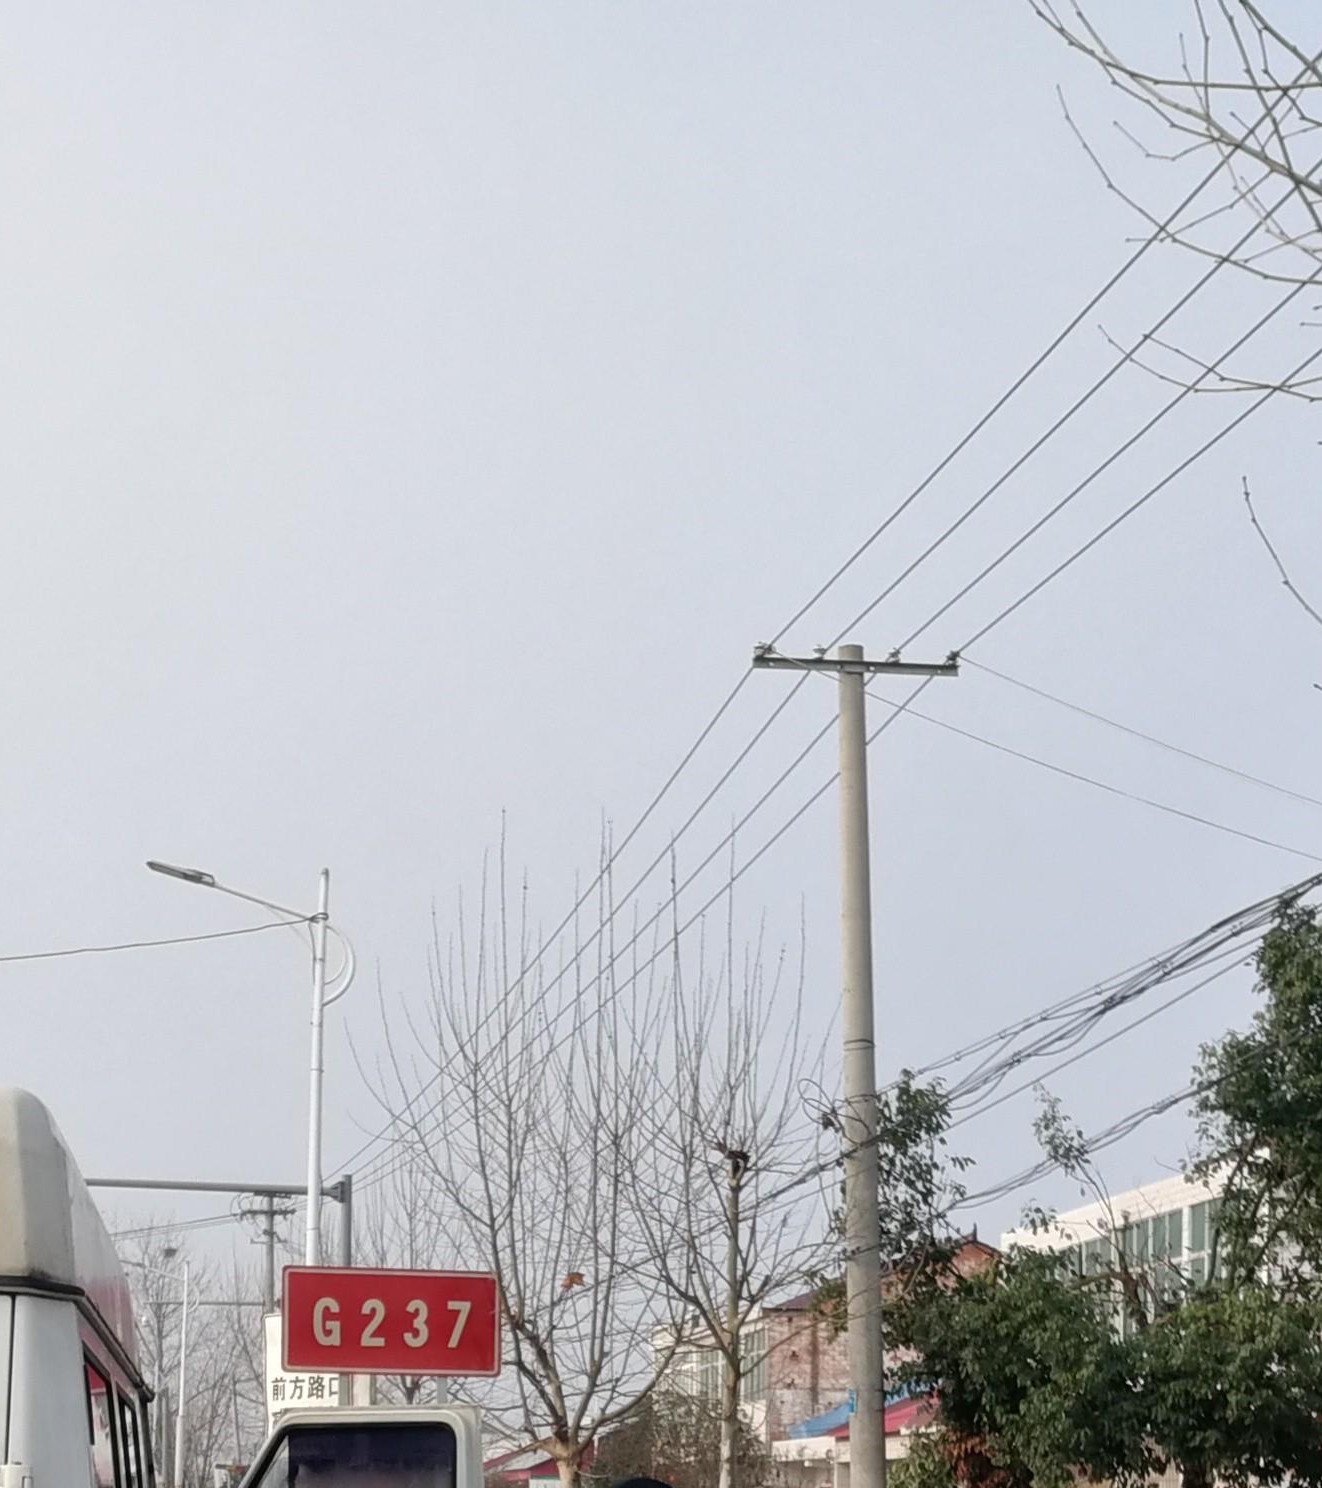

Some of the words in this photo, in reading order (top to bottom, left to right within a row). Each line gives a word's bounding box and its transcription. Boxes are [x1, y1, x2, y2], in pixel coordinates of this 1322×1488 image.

[313, 1297, 472, 1348] G237
[271, 1376, 339, 1401] 前方路口
